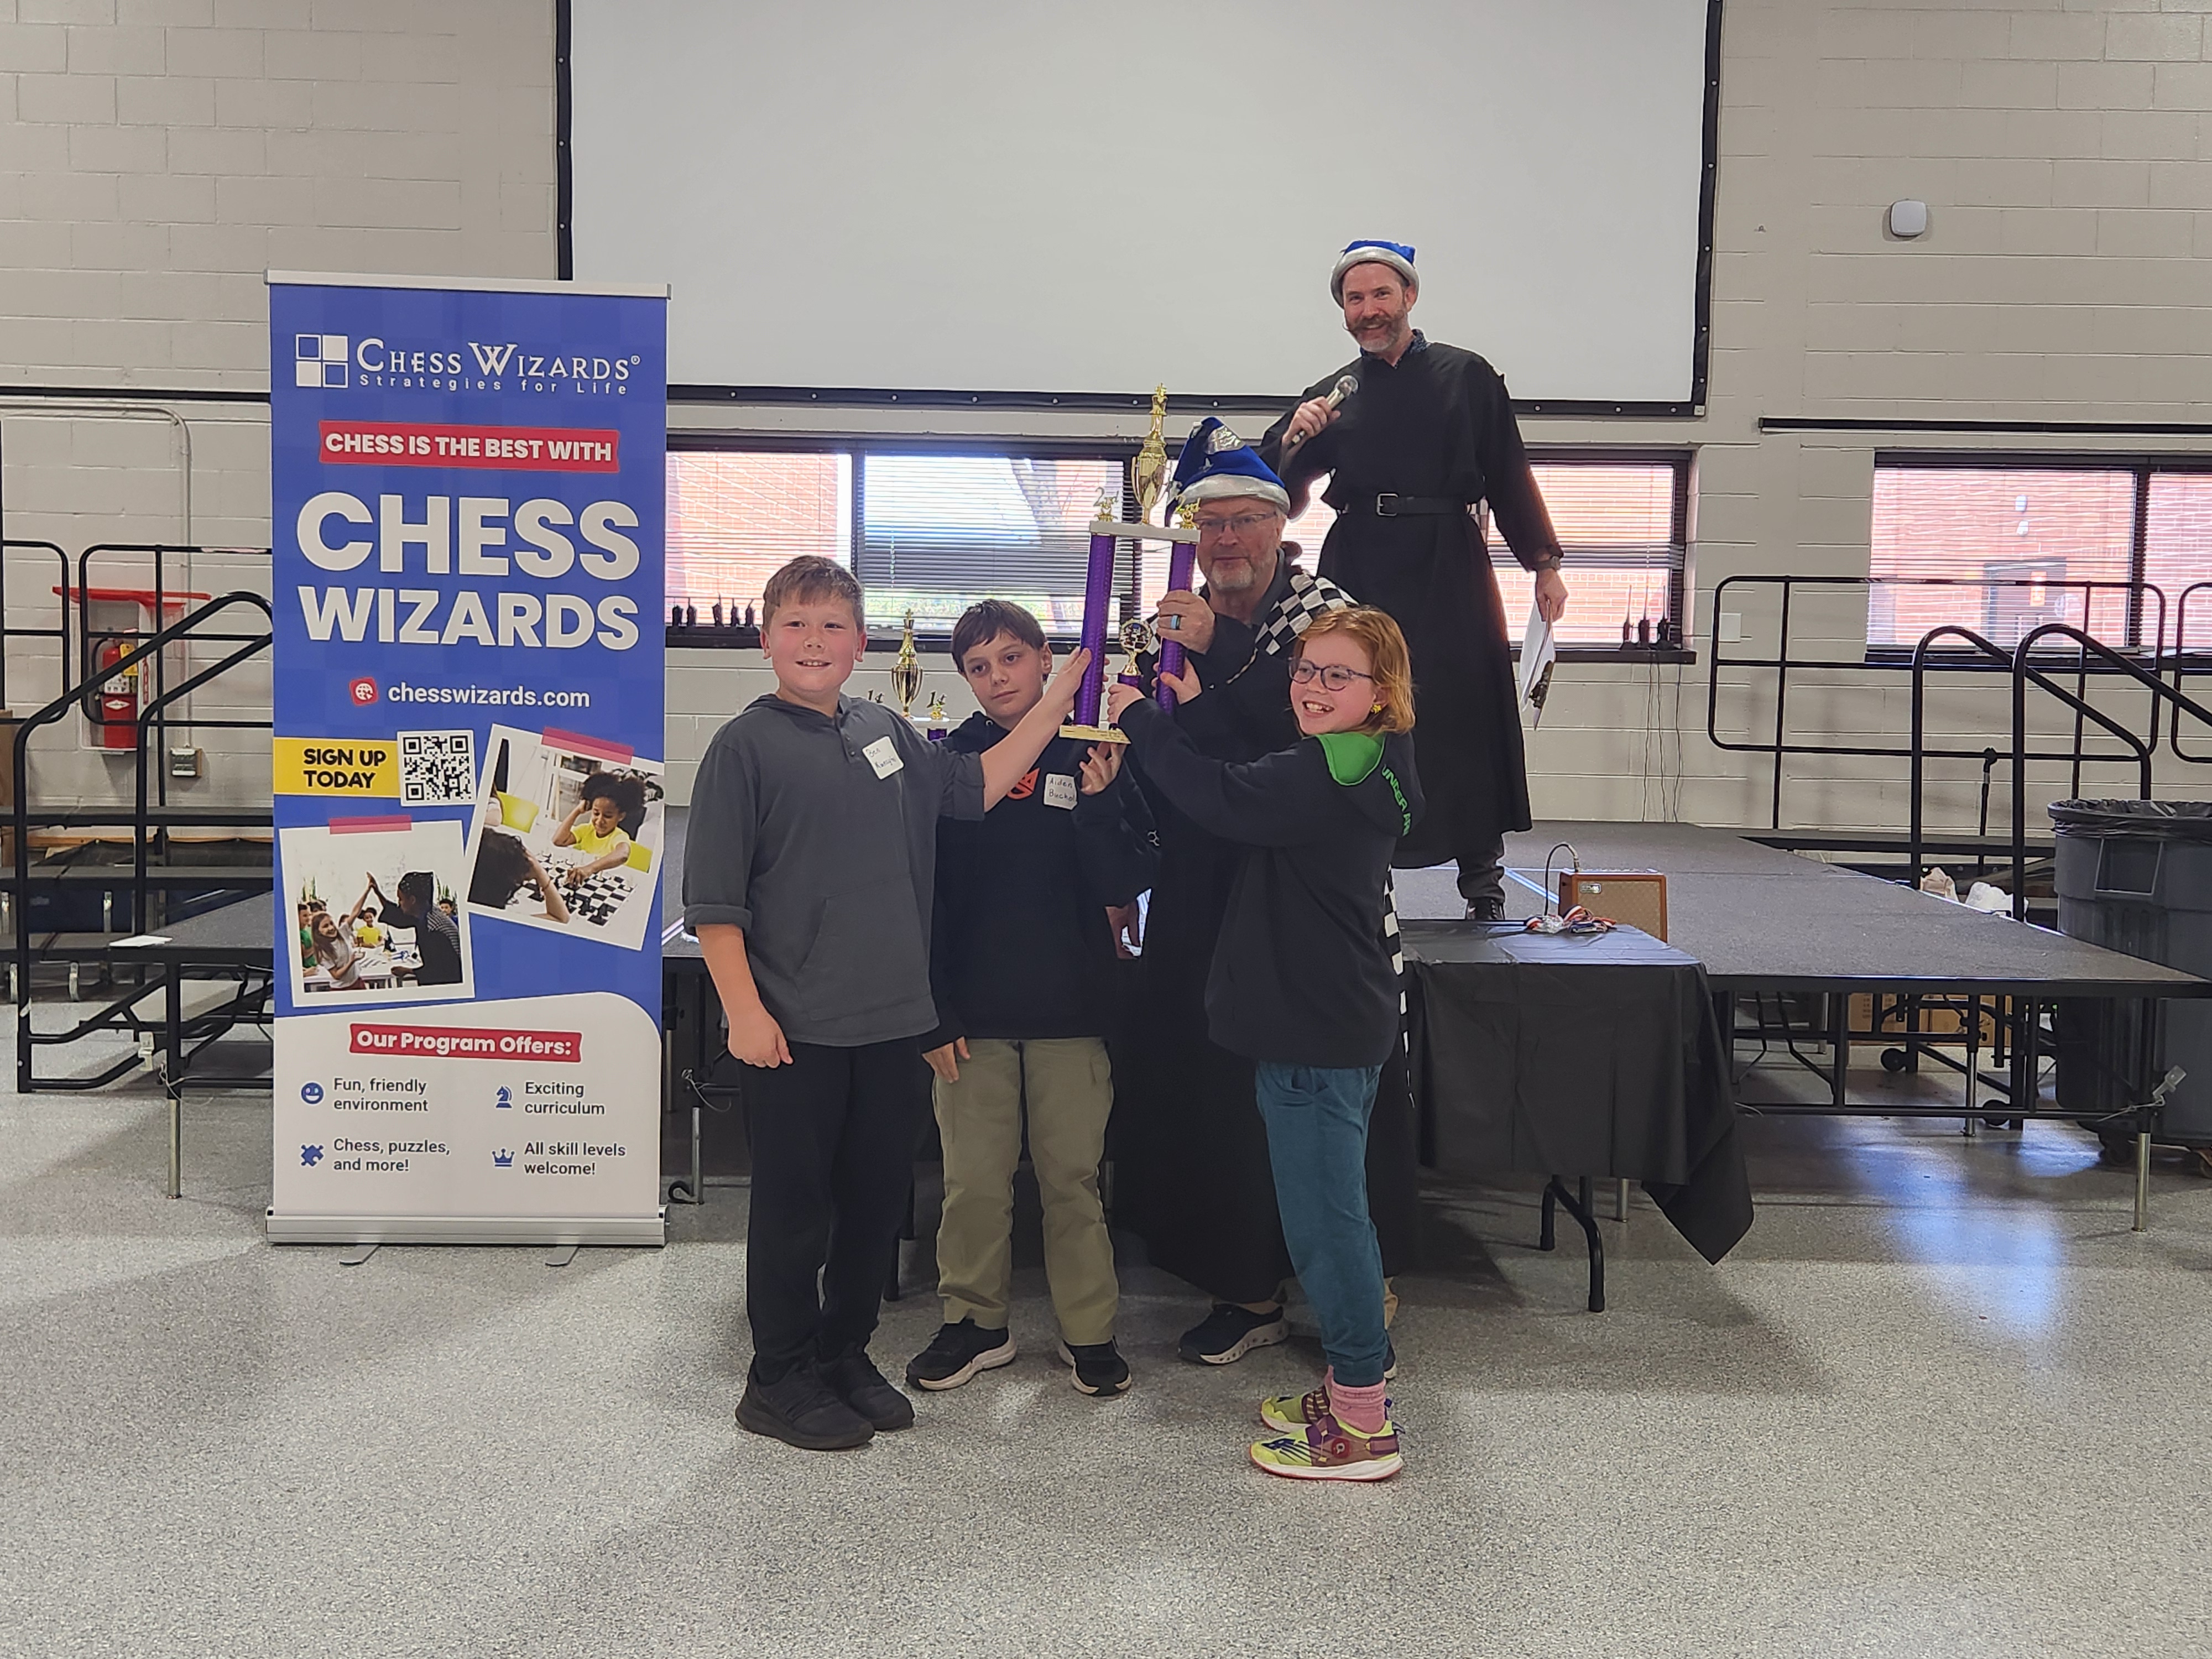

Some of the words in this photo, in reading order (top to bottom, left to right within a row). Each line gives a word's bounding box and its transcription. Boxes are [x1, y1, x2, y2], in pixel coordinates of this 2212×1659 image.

[357, 338, 461, 375] CHESS
[361, 374, 501, 390] Strategies
[522, 380, 556, 392] for
[577, 382, 625, 394] Life
[326, 434, 404, 453] CHESS
[409, 436, 430, 454] IS
[435, 437, 479, 456] THE
[486, 439, 543, 458] BEST
[548, 441, 611, 461] WITH
[298, 492, 639, 580] CHESS
[298, 586, 638, 649] WIZARDS
[389, 682, 589, 707] chesswizards.com
[304, 749, 353, 765] SIGN
[360, 750, 386, 766] UP
[304, 770, 375, 788] TODAY
[1048, 777, 1073, 789] Aiden
[1382, 764, 1408, 812] UNDER
[357, 1031, 397, 1047] Our
[401, 1033, 495, 1055] Program
[500, 1036, 571, 1055] Offers:
[335, 1078, 364, 1093] Fun,
[370, 1078, 426, 1095] friendly
[525, 1082, 583, 1098] Exciting
[335, 1098, 427, 1111] environment
[525, 1101, 604, 1114] curriculum
[335, 1139, 383, 1154] Chess,
[389, 1140, 449, 1155] puzzles,
[525, 1142, 543, 1155] All
[549, 1142, 577, 1155] skill
[583, 1142, 625, 1156] levels
[334, 1158, 361, 1170] and
[367, 1159, 408, 1171] more!
[524, 1161, 594, 1175] welcome!
